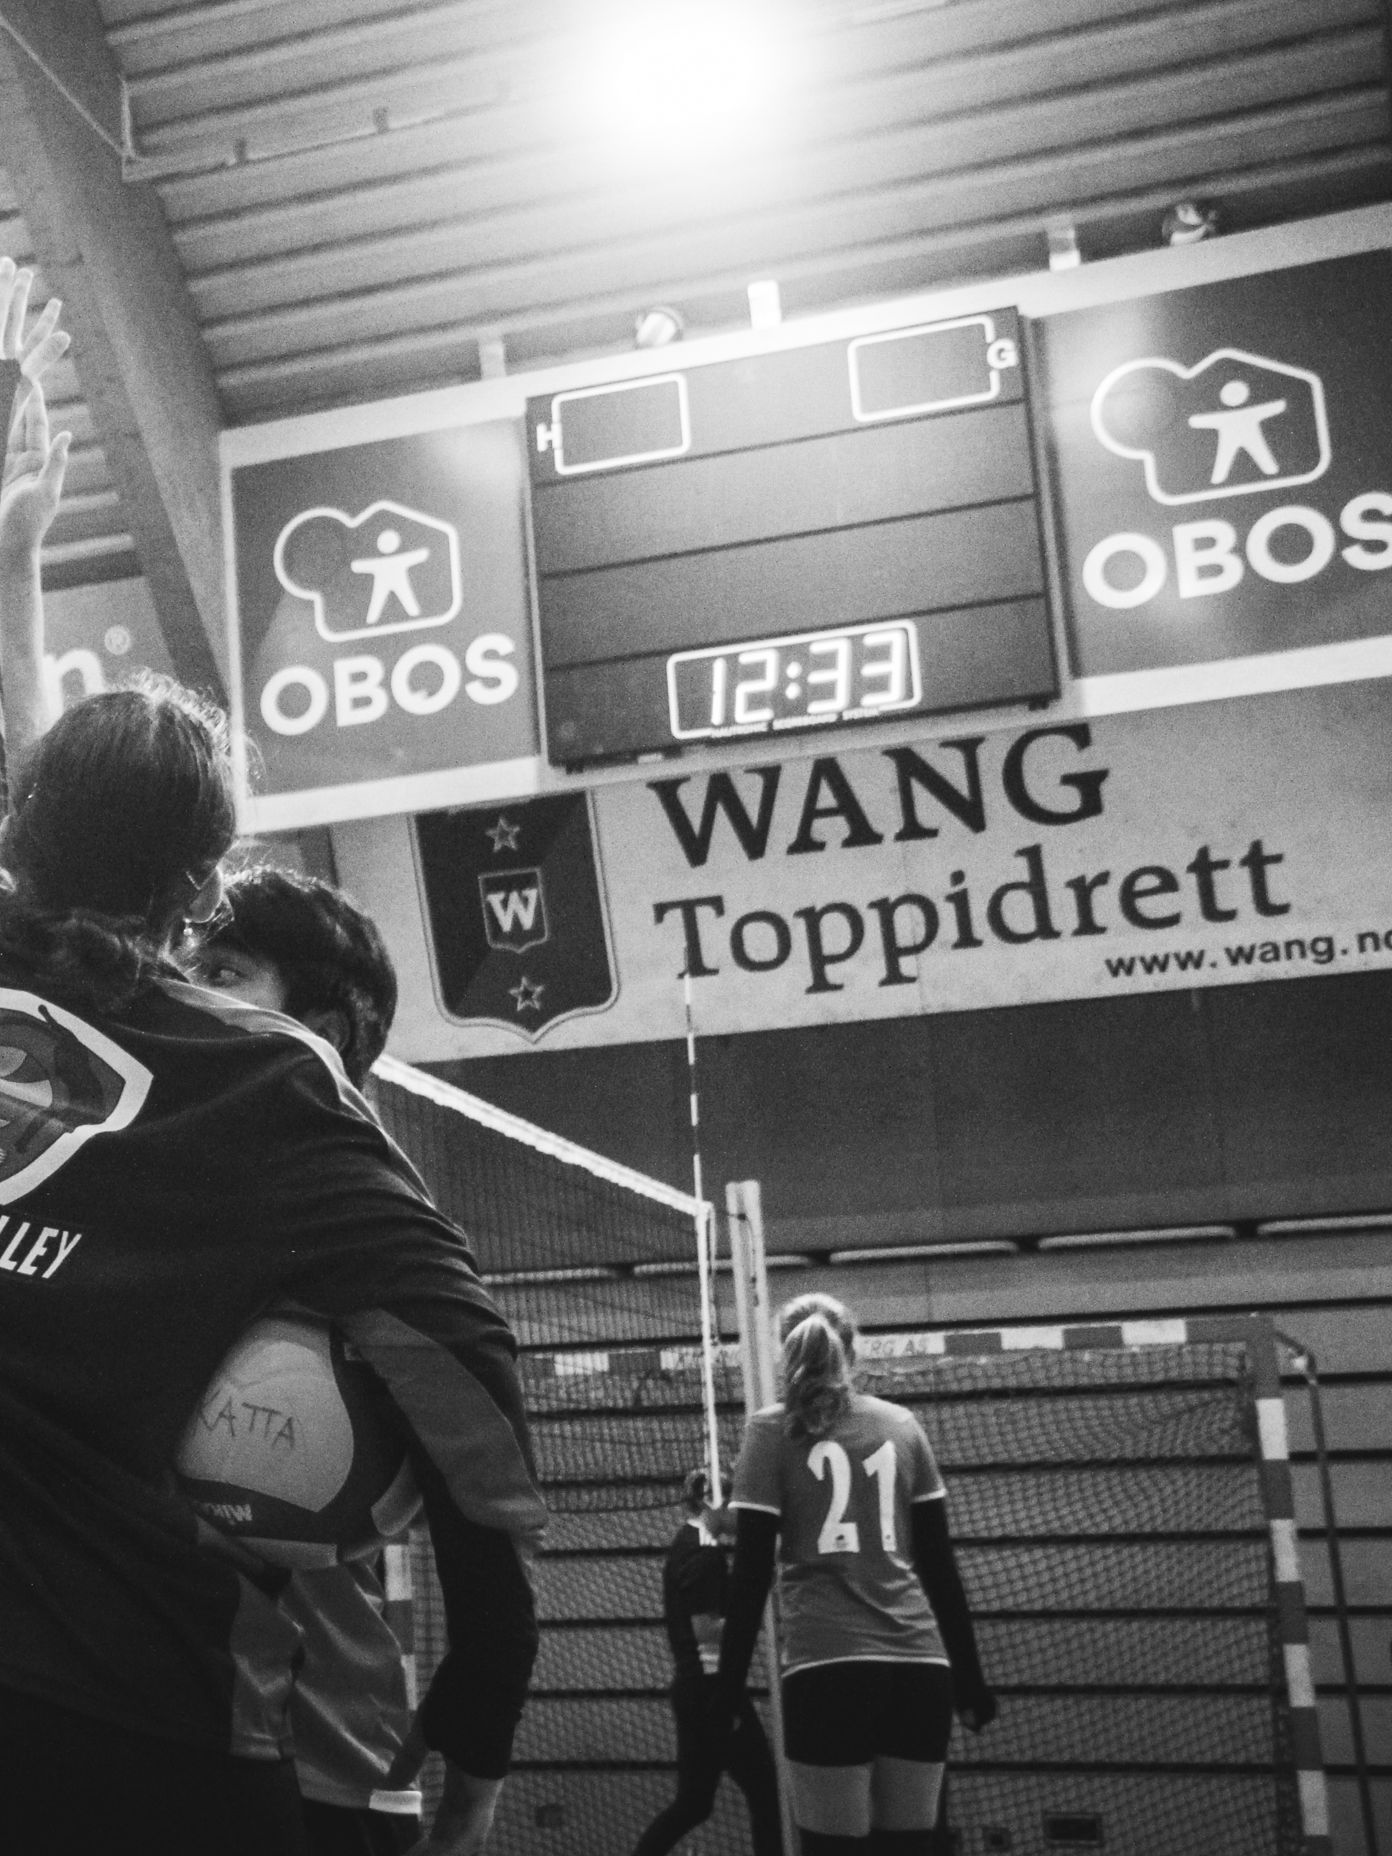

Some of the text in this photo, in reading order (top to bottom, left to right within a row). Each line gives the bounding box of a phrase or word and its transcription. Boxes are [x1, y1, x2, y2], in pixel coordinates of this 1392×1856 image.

[986, 338, 1019, 369] G
[536, 422, 563, 453] H
[1082, 491, 1392, 609] OBOS
[259, 632, 519, 736] OBOS
[710, 628, 907, 726] 12:33
[646, 722, 1109, 869] WANG
[486, 887, 538, 932] W
[653, 839, 1292, 996] Toppidrett
[807, 1440, 897, 1554] 21
